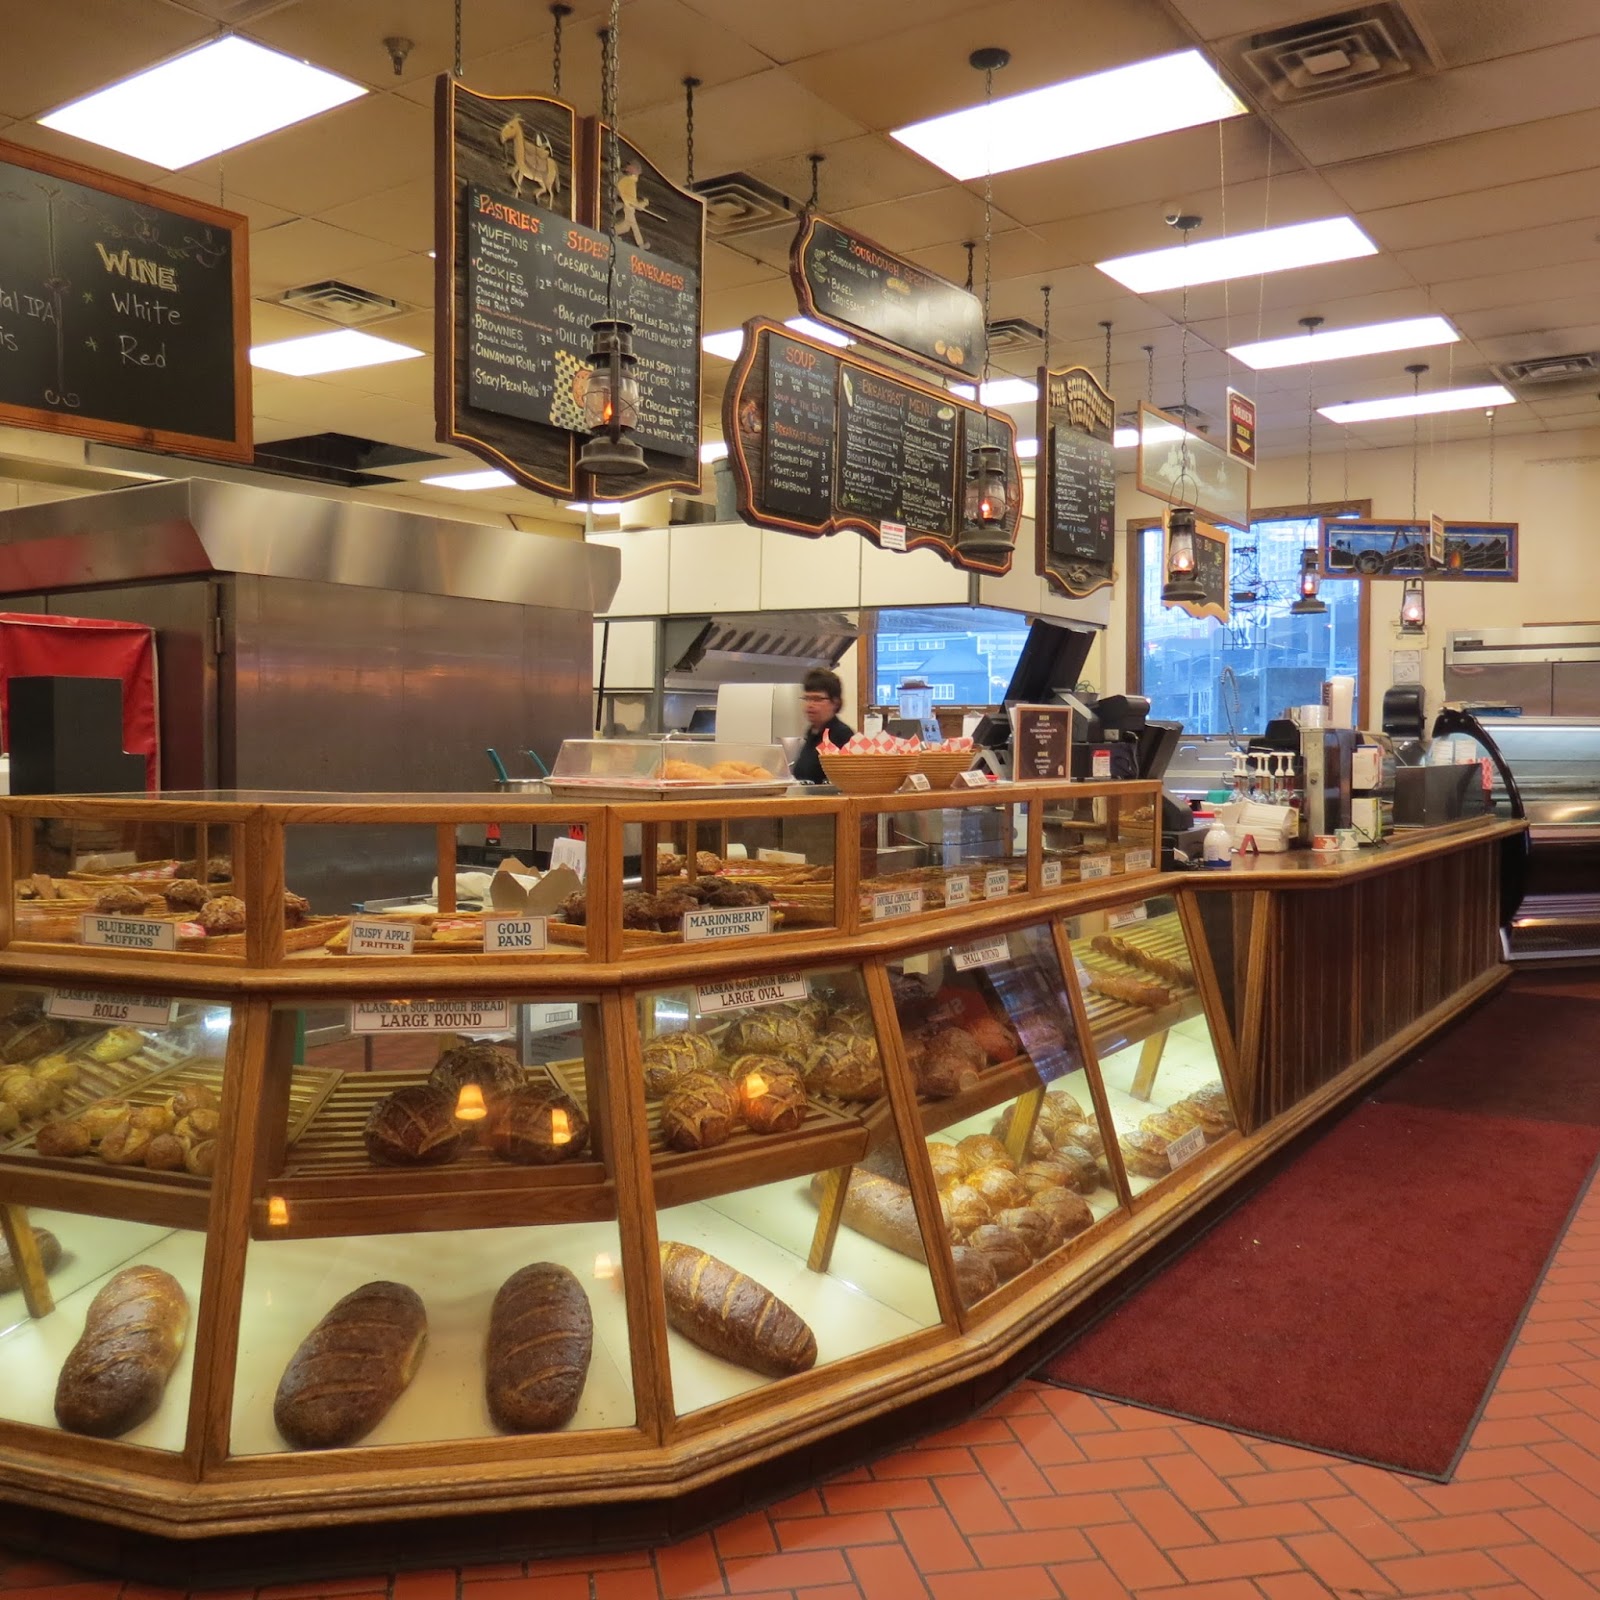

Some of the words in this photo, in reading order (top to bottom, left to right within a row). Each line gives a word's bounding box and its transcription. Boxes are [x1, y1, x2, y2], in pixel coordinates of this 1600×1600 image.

[479, 194, 540, 234] PASTRIES
[478, 222, 529, 252] MUFFINS
[567, 230, 609, 260] SIDES
[96, 242, 176, 292] WINE
[557, 252, 589, 278] CAESAR
[849, 239, 899, 277] SOURDOUGH
[476, 257, 524, 286] COOKIES
[630, 254, 685, 291] BEVERAGES
[476, 285, 509, 303] Chocolate
[558, 278, 588, 299] CHICKEN
[831, 277, 854, 297] BAGEL
[24, 295, 57, 324] IPA
[111, 292, 182, 325] White
[830, 291, 866, 314] CROISSANT
[558, 304, 575, 323] BAG
[475, 313, 523, 341] BROWNIES
[119, 335, 167, 368] Red
[475, 343, 515, 366] CINNAMON
[786, 346, 816, 373] SOUP
[656, 360, 677, 377] SPRAY
[862, 379, 906, 408] BREAKFAST
[909, 397, 934, 418] MENU
[1232, 403, 1253, 426] ORDER
[876, 894, 894, 906] DOUBLE
[894, 891, 919, 903] CHOCOLATE
[884, 902, 911, 916] BROWNIES
[97, 920, 162, 937] BLUEBERRY
[497, 922, 532, 934] GOLD
[690, 910, 765, 928] MARIONBERRY
[104, 934, 154, 947] MUFFINS
[353, 926, 383, 940] CRISPY
[385, 929, 411, 942] APPLE
[497, 934, 532, 947] PANS
[705, 924, 750, 937] MUFFINS
[360, 940, 406, 951] FRITTER
[962, 950, 981, 966] SMALL
[981, 948, 1000, 961] ROUND
[700, 982, 734, 997] ALASKAN
[735, 976, 776, 991] SOURDOUGH
[777, 972, 800, 984] BREAD
[357, 1001, 410, 1014] ALASKAN
[410, 1001, 468, 1014] SOURDOUGH
[470, 1000, 504, 1011] BREAD
[720, 990, 756, 1007] LARGE
[758, 986, 785, 1001] OVAL
[93, 1004, 128, 1019] ROLLS
[380, 1014, 429, 1028] LARGE
[434, 1013, 482, 1026] ROUND
